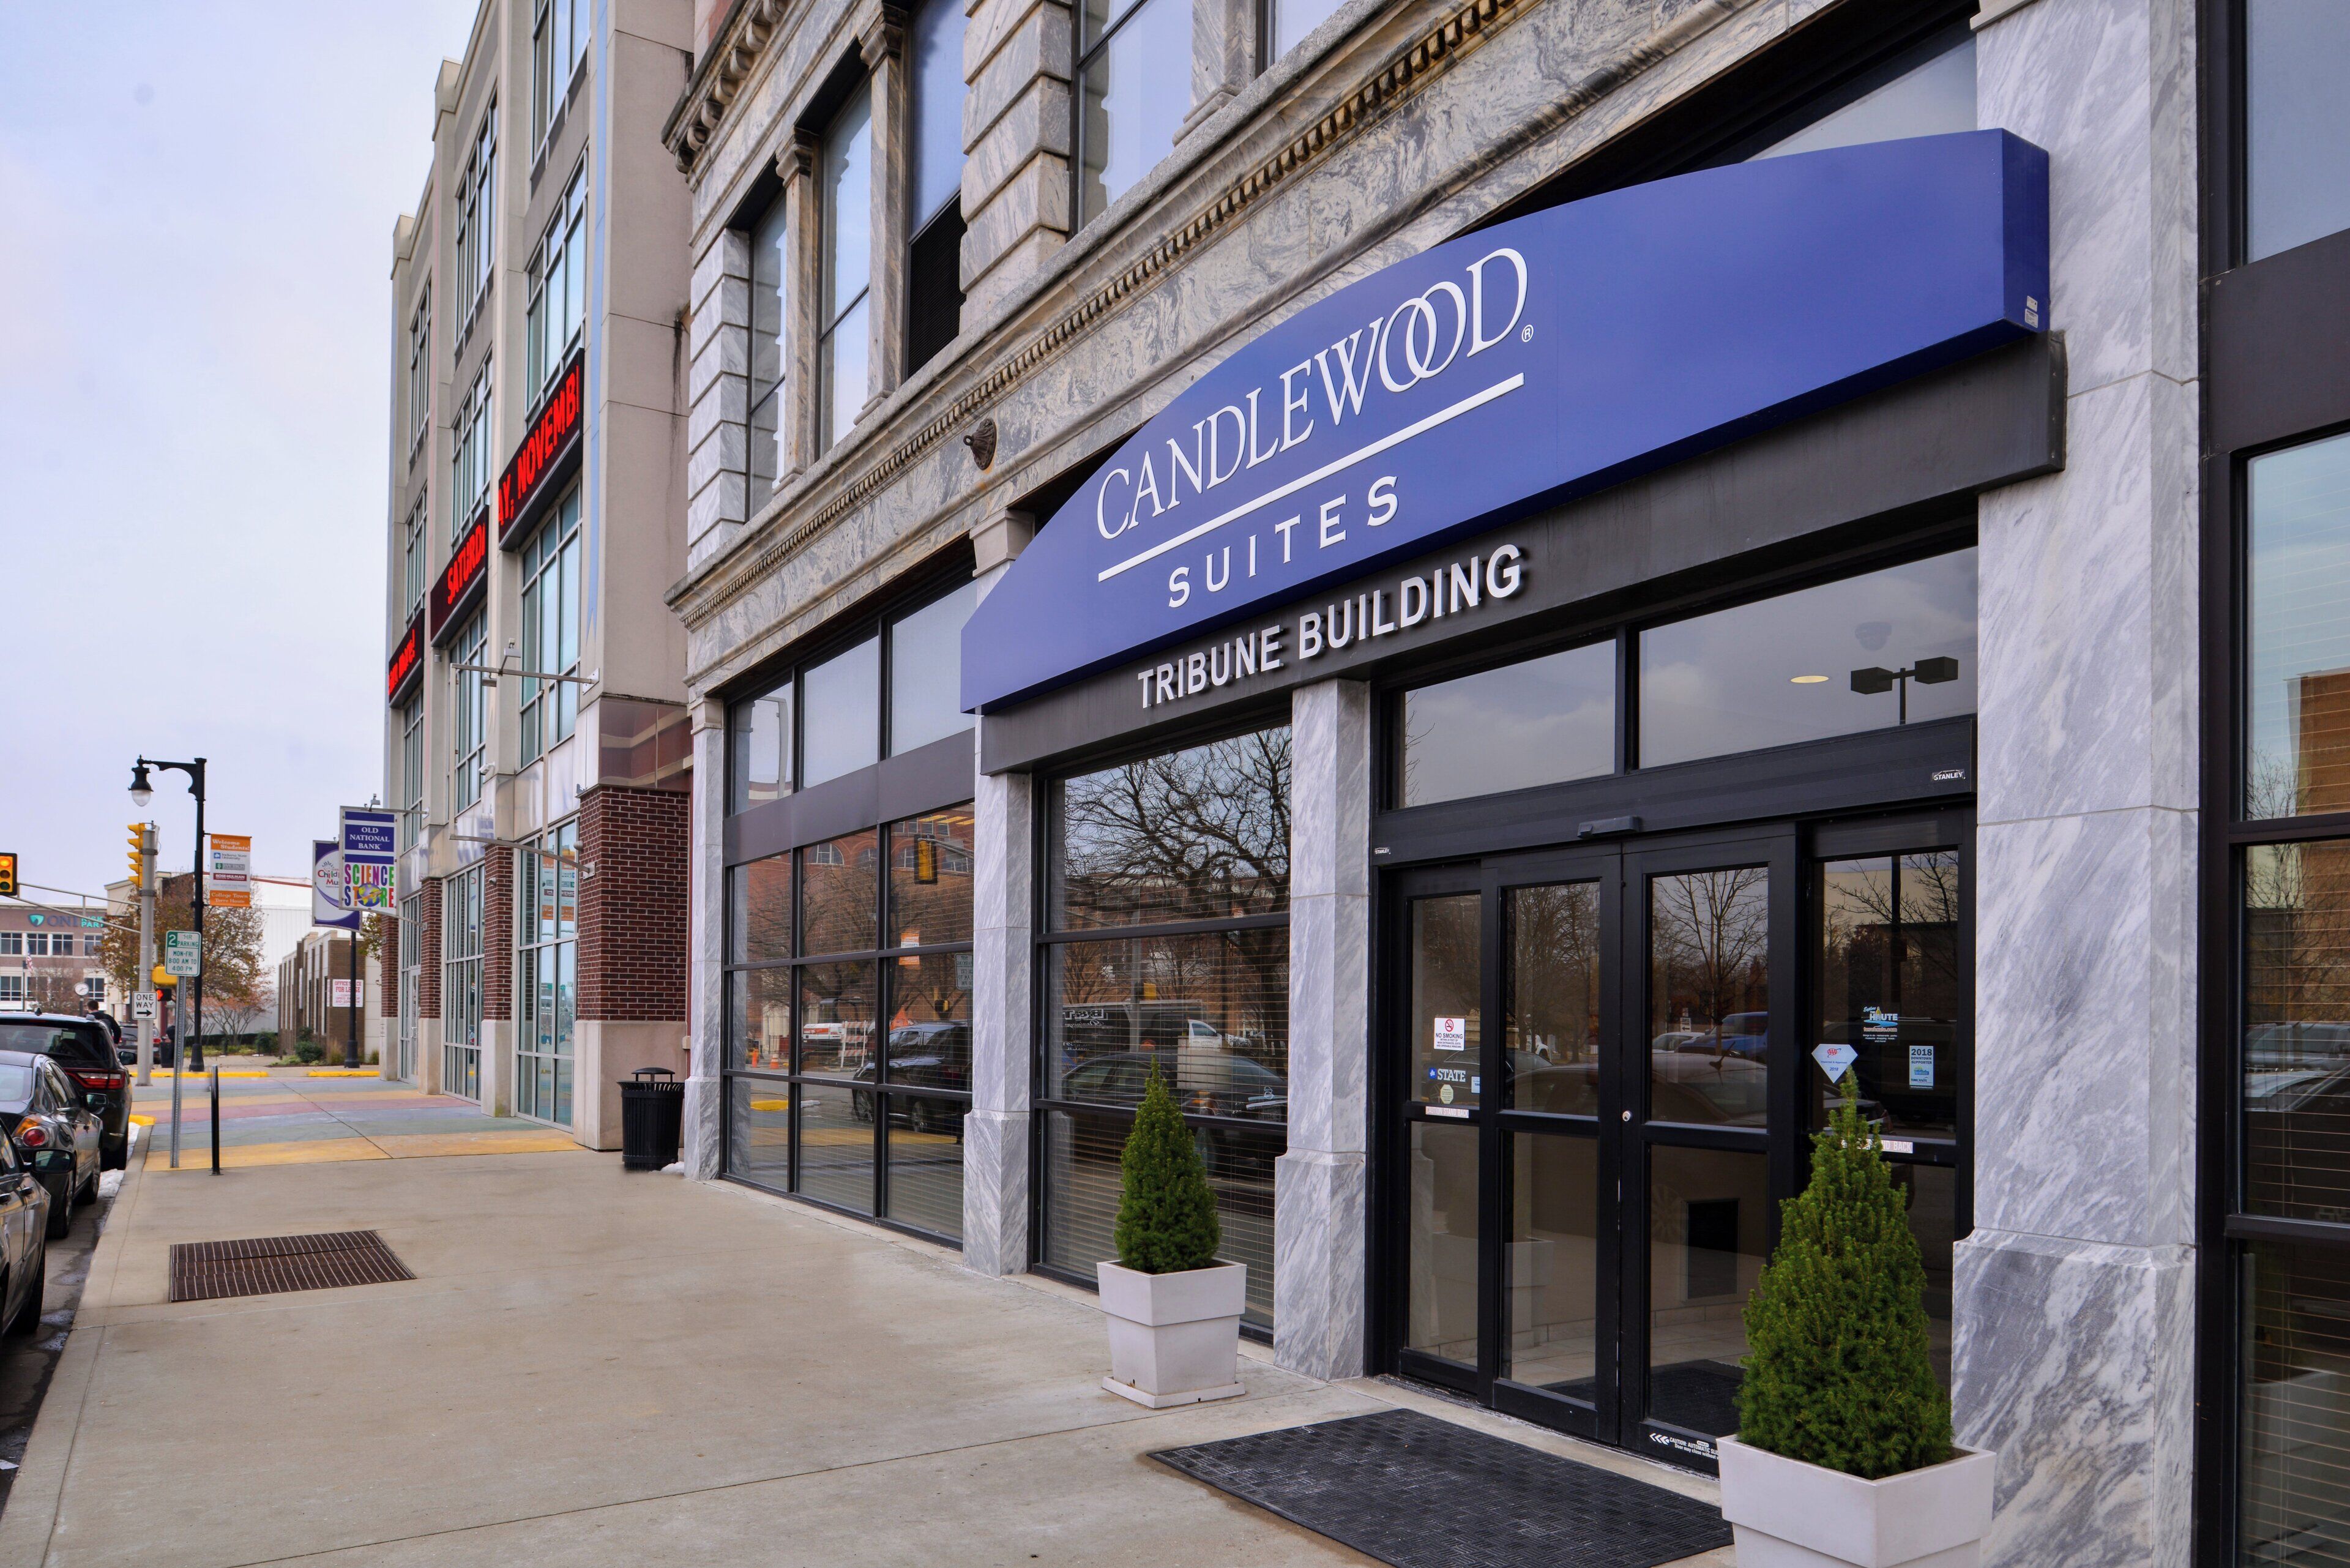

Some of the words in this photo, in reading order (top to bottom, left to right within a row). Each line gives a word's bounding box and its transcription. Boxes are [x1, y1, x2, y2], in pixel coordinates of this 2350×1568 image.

[1097, 248, 1529, 540] CANDLEWOOD
[518, 366, 579, 499] NOVEMB
[1169, 476, 1398, 608] SUITES
[1138, 624, 1283, 709] TRIBUNE
[1299, 544, 1521, 660] BUILDING
[1934, 772, 1963, 780] STANLEY
[349, 834, 390, 843] NATIONAL
[318, 870, 340, 878] Child
[345, 864, 394, 887] SCIENCE
[168, 934, 176, 946] 2
[1438, 1069, 1466, 1082] STATE
[1893, 1141, 1911, 1152] BACK
[1669, 1437, 1687, 1446] CAUTION:
[1688, 1443, 1710, 1452] AUTOMATIC
